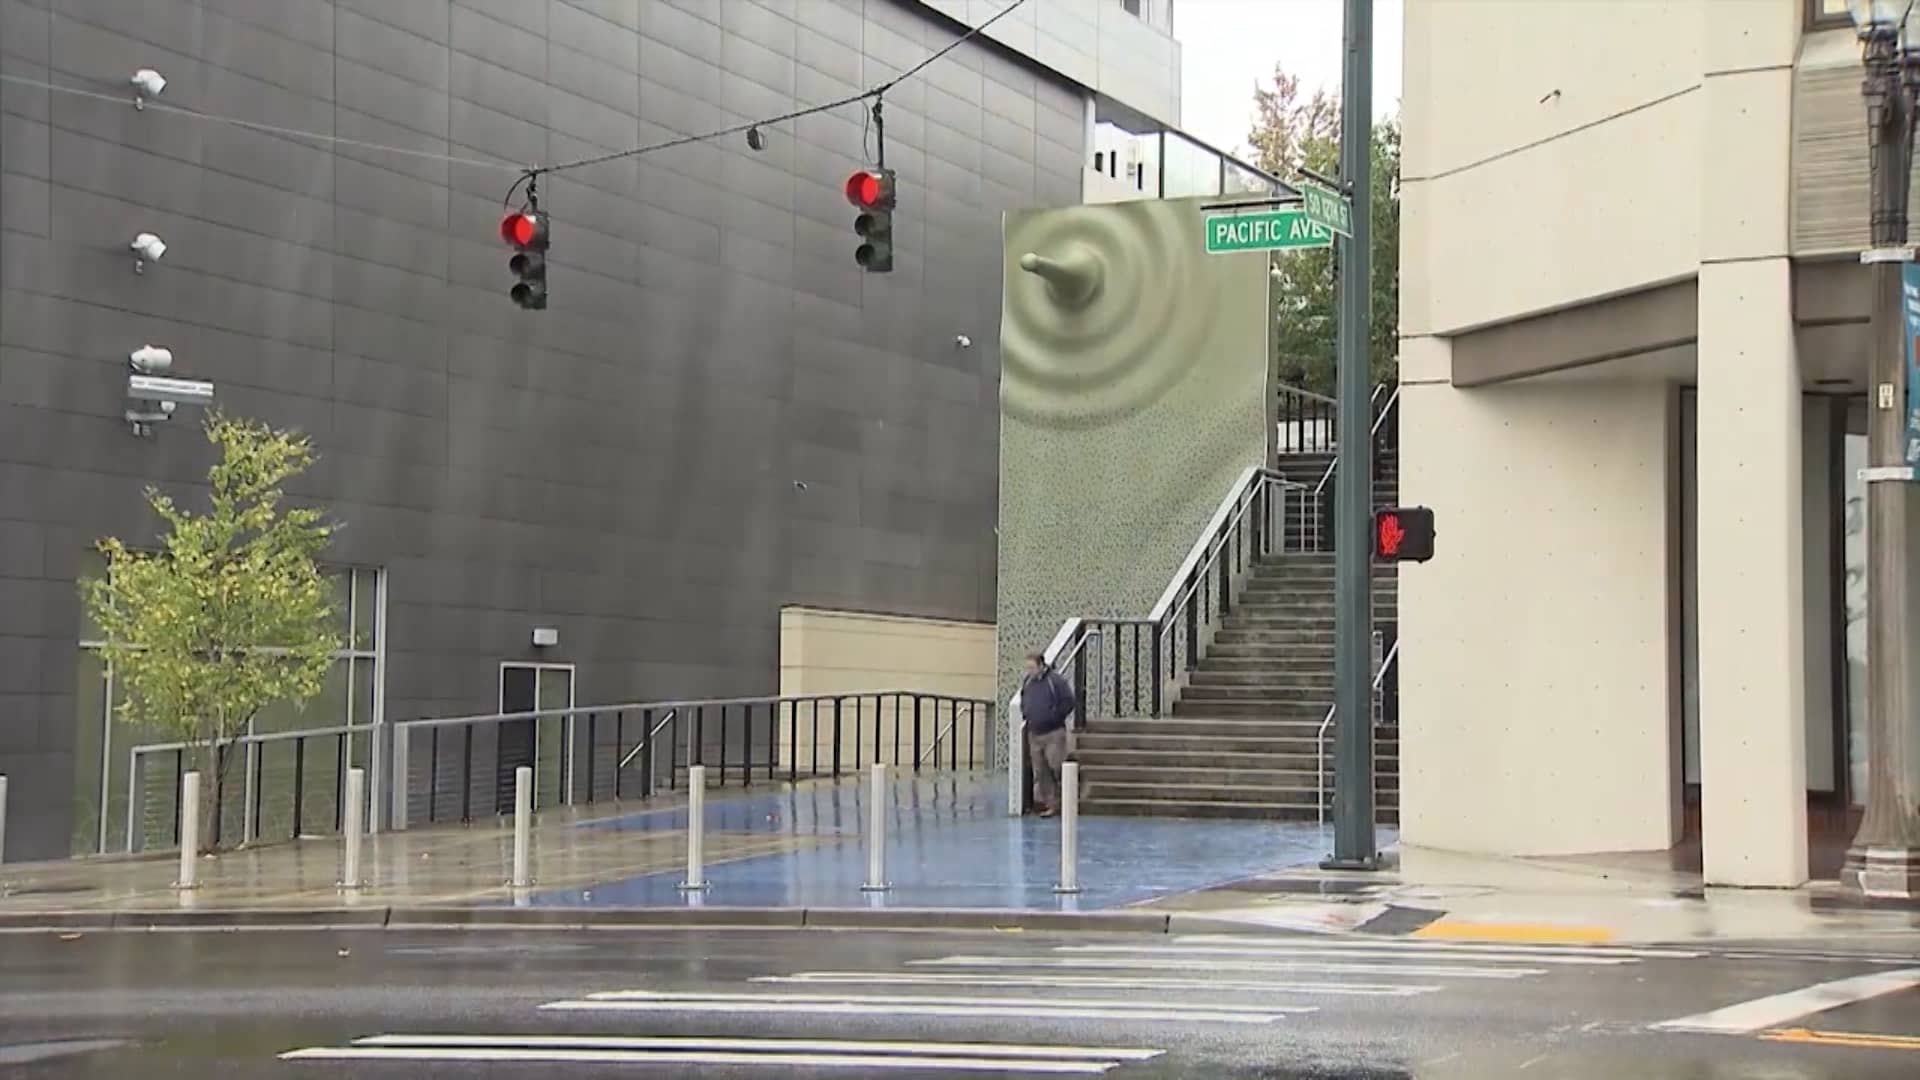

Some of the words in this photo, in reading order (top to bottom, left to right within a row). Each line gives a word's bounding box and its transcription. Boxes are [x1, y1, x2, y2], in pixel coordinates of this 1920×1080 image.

[1340, 205, 1348, 226] ST
[1216, 219, 1282, 244] PACIFIC
[1289, 219, 1322, 241] AVE
